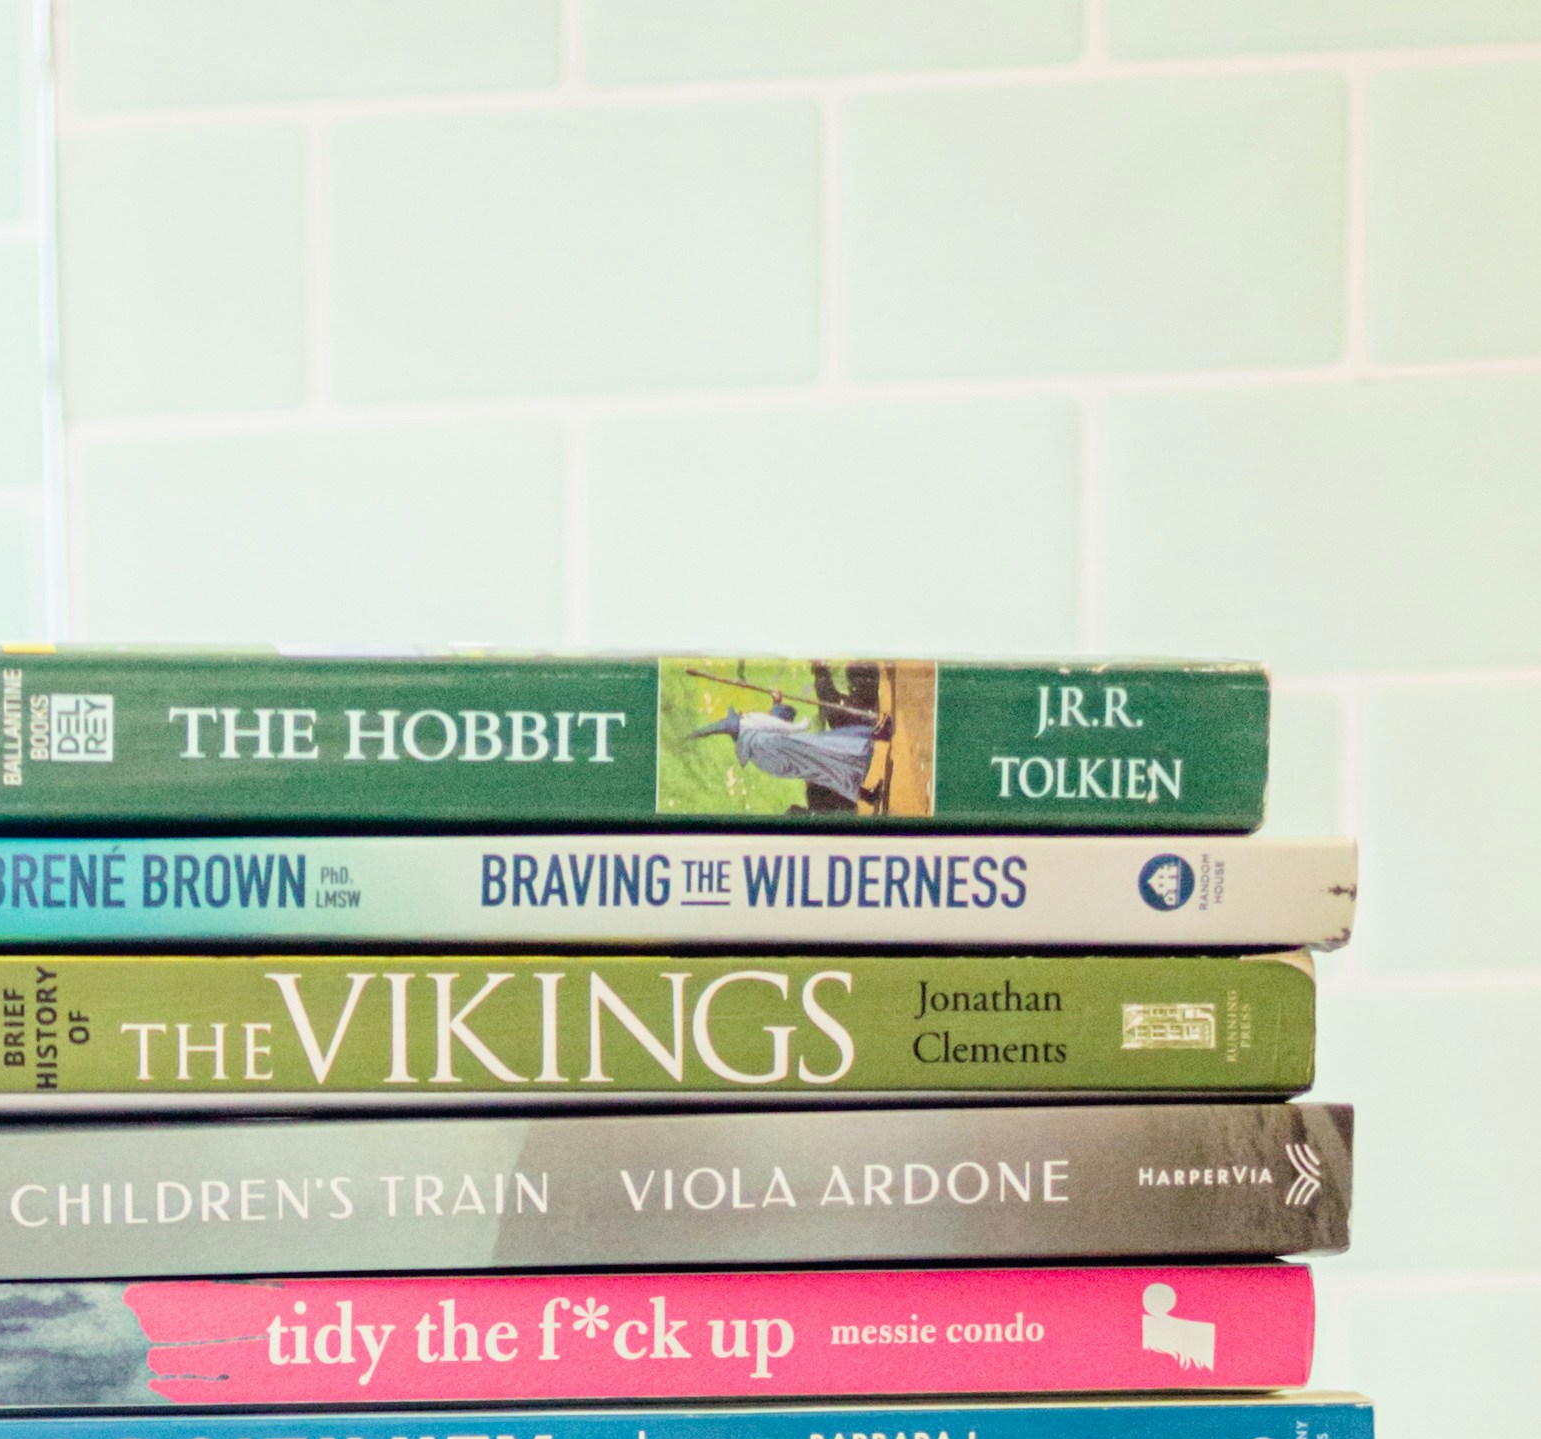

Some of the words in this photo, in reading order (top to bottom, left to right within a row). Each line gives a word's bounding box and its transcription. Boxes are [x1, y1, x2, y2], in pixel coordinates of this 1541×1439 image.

[3, 668, 22, 785] BALLANTINE
[30, 694, 49, 761] BOOKS
[169, 707, 320, 759] THE
[345, 709, 626, 763] HOBBIT
[1034, 687, 1143, 738] J.R.R.
[991, 757, 1183, 801] TOLKIEN
[143, 854, 307, 907] BROWN
[482, 854, 670, 906] BRAVING
[681, 860, 731, 894] THE
[743, 856, 1028, 909] WILDERNESS
[3, 988, 26, 1067] BRIEF
[36, 967, 59, 1088] HISTORY
[69, 1010, 89, 1044] OF
[914, 981, 1063, 1019] Jonathan
[120, 1022, 274, 1081] THE
[264, 971, 855, 1085] VIKINGS
[913, 1030, 1068, 1065] Clements
[10, 1177, 355, 1228] CHILDREN'S
[378, 1173, 549, 1216] TRAIN
[620, 1166, 797, 1212] VIOLA
[820, 1160, 1070, 1208] ARDONE
[267, 1301, 396, 1385] tidy
[414, 1298, 518, 1364] the
[709, 1316, 795, 1378] up
[831, 1313, 937, 1346] messie
[946, 1311, 1045, 1344] condo
